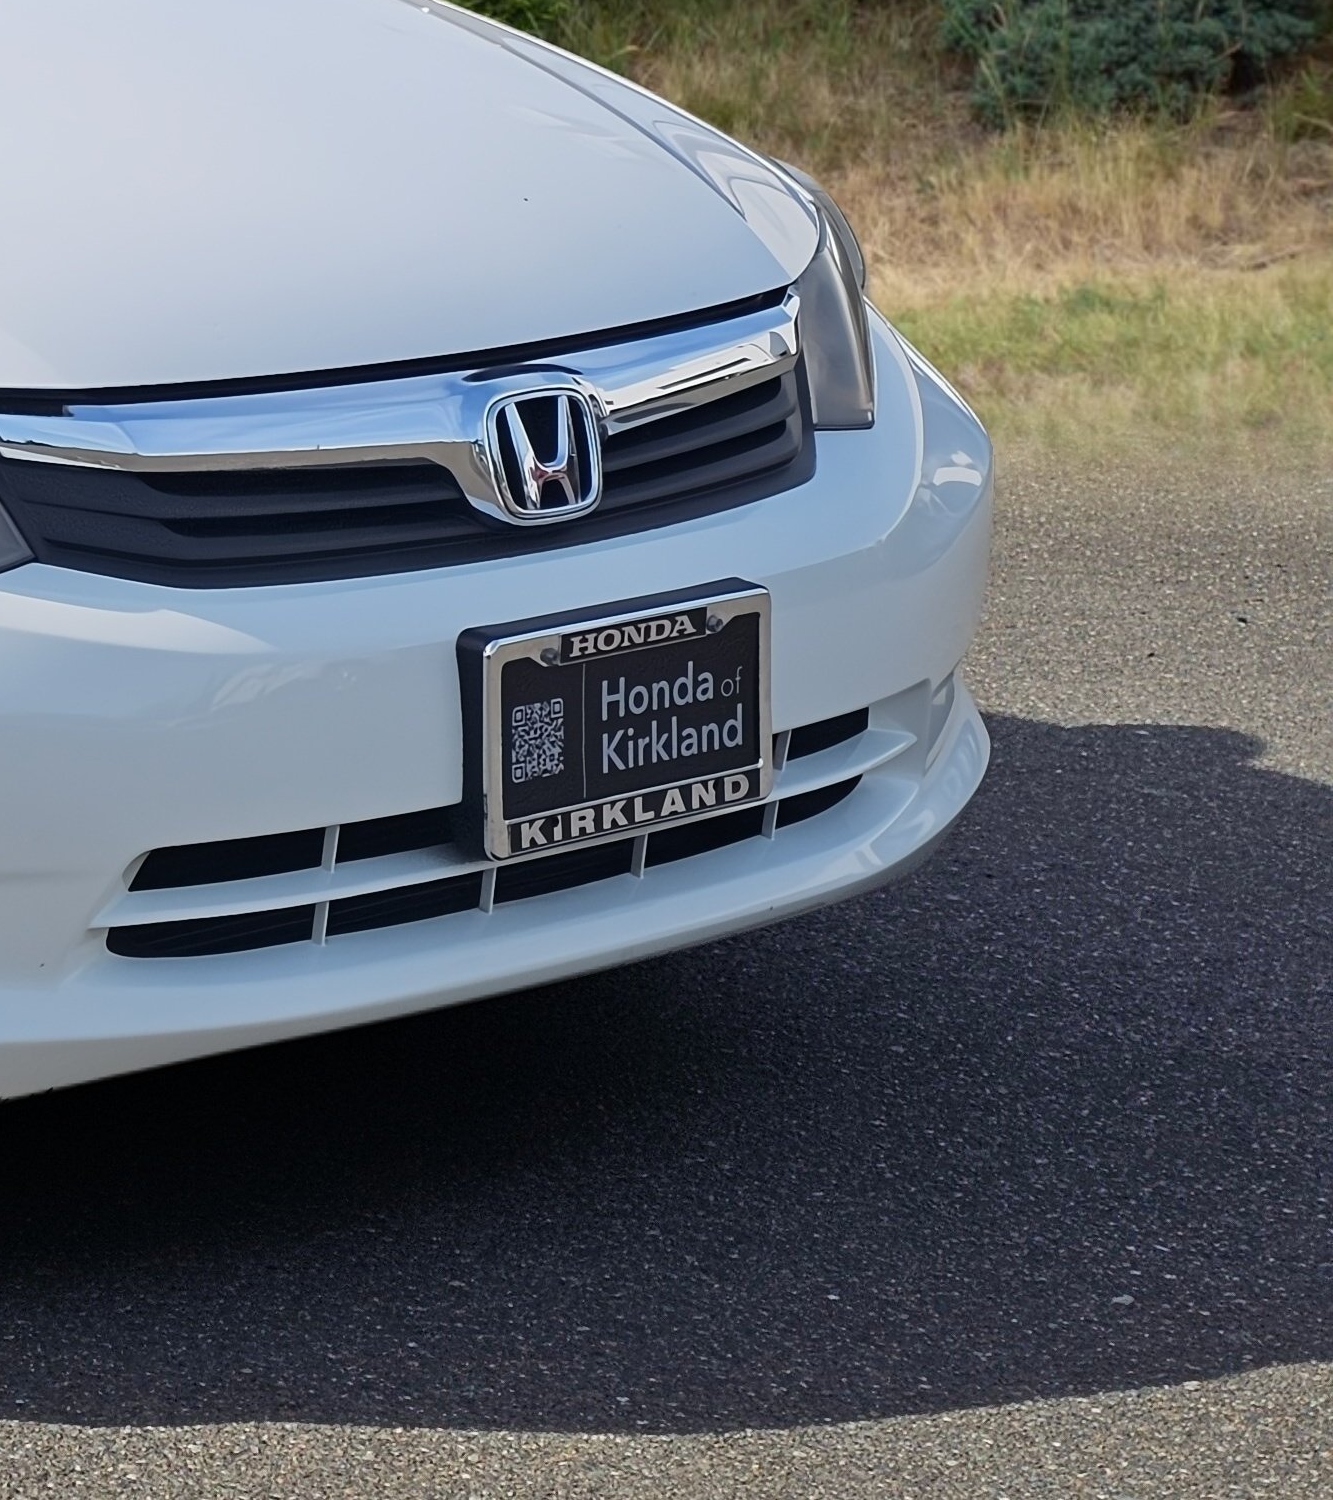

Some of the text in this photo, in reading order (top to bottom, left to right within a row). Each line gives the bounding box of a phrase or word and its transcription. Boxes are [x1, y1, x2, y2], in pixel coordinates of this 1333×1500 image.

[568, 614, 698, 659] HONDA
[600, 660, 744, 722] Honda of
[601, 702, 744, 775] Kirkland
[519, 772, 751, 850] KIRKLAND
